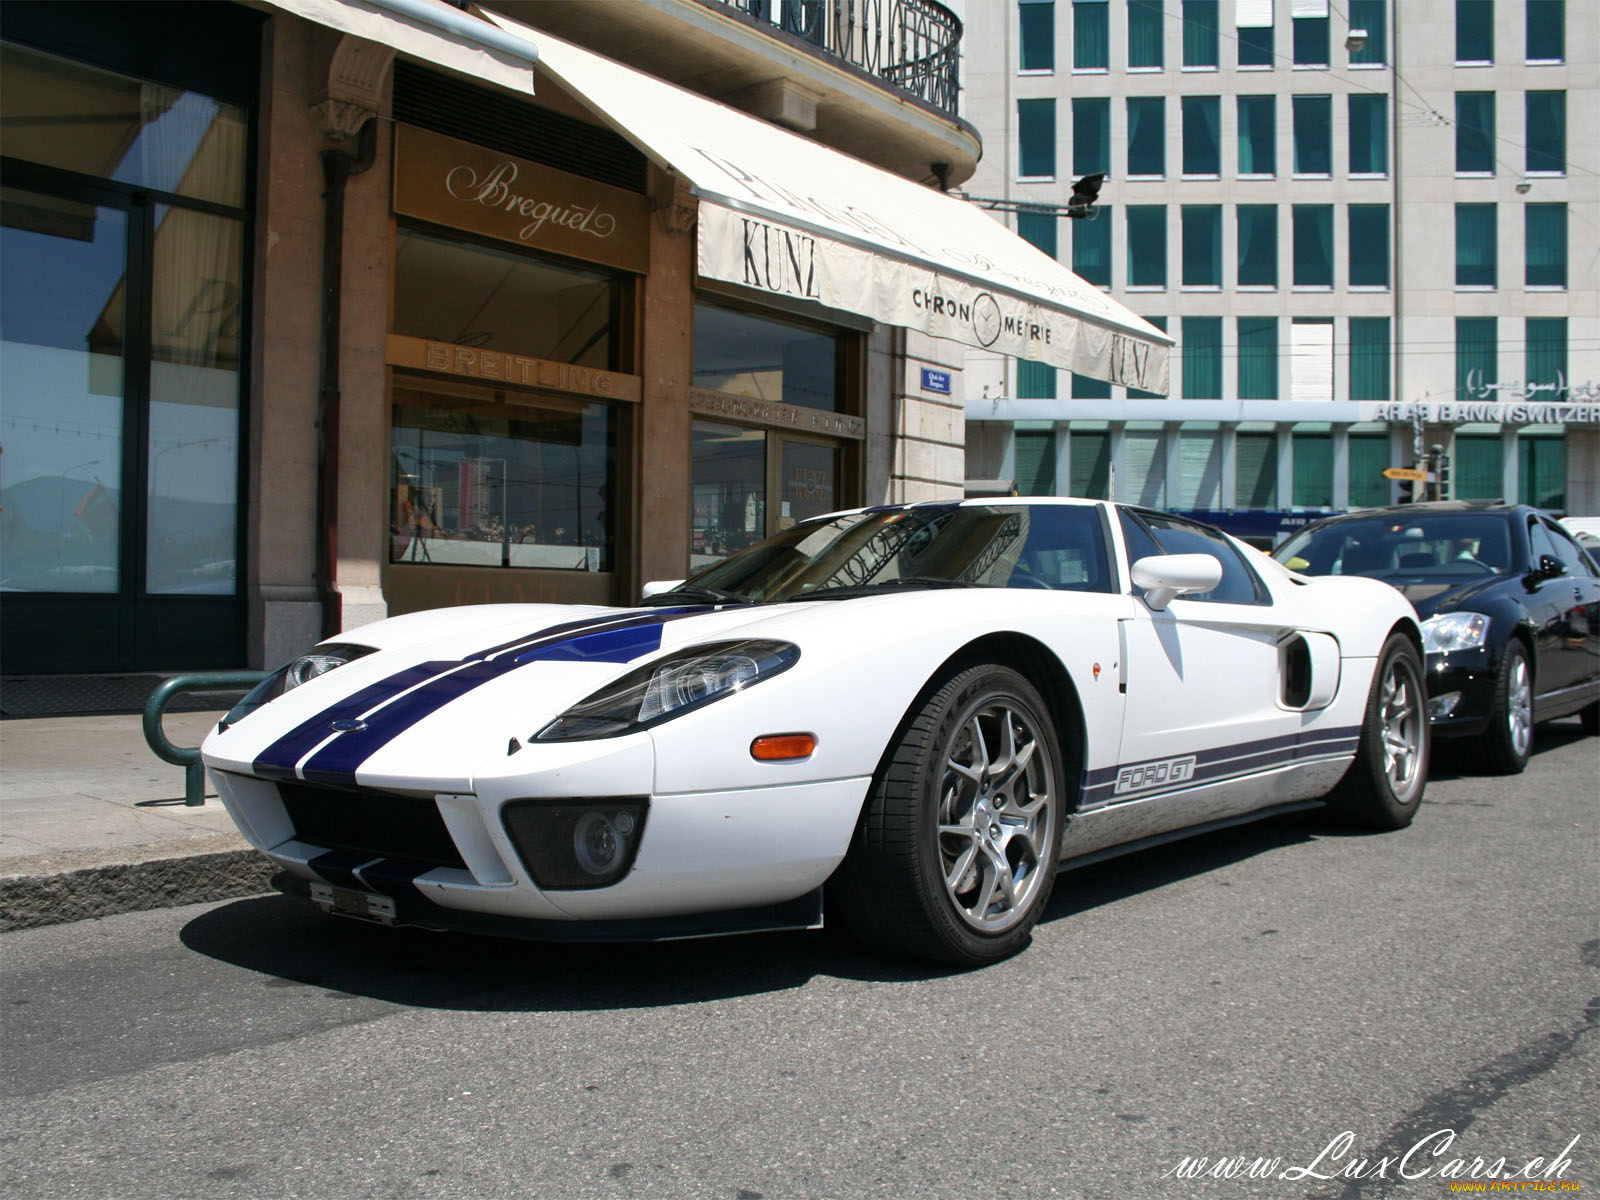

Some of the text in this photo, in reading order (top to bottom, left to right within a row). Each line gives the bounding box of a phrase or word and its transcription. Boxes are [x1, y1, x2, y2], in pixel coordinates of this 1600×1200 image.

[446, 161, 616, 240] Breguet
[741, 218, 820, 298] KUNZ
[426, 343, 612, 394] BREITLING
[1374, 402, 1429, 422] ARAB
[1440, 403, 1498, 422] BANK
[1281, 518, 1306, 526] AIR
[1117, 758, 1195, 791] FORD GT
